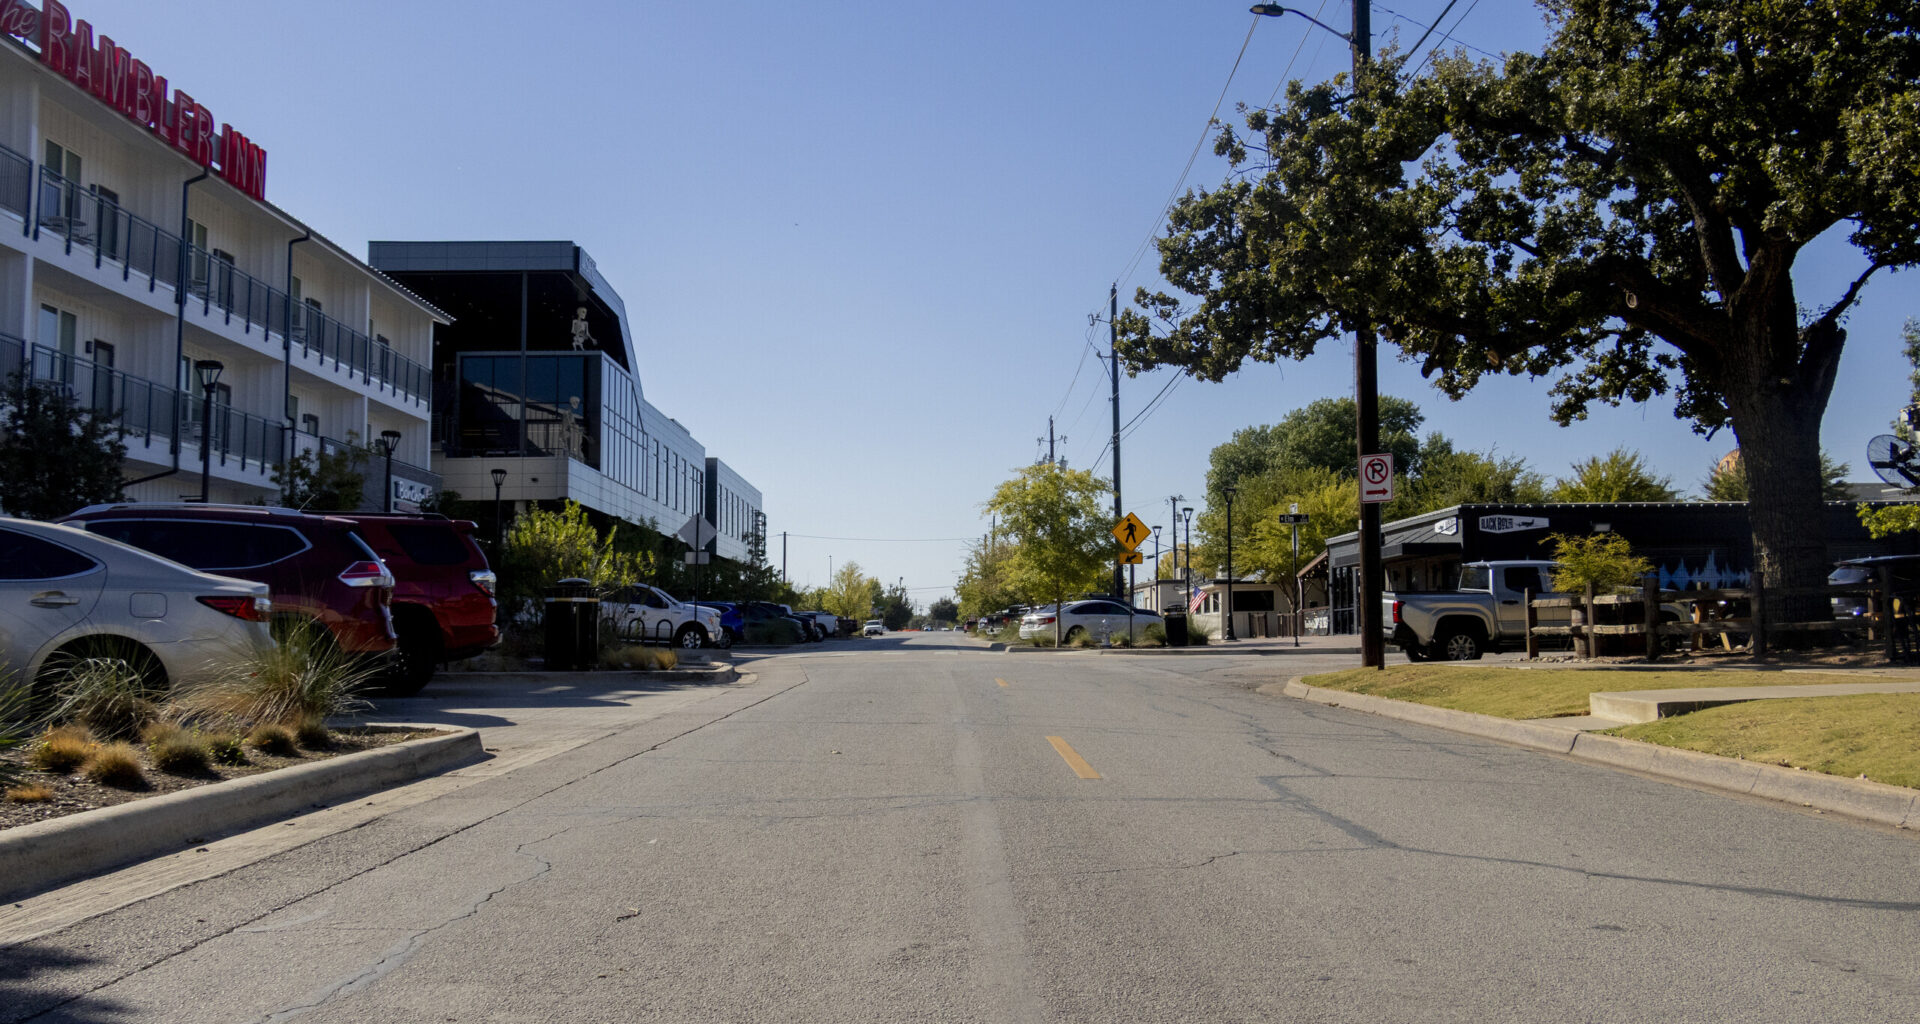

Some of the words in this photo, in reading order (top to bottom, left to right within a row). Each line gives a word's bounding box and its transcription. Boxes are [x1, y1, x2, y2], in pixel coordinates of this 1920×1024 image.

[0, 0, 38, 37] he
[41, 0, 214, 168] RAMBLER
[220, 123, 267, 200] INN
[1480, 518, 1497, 531] BLACK
